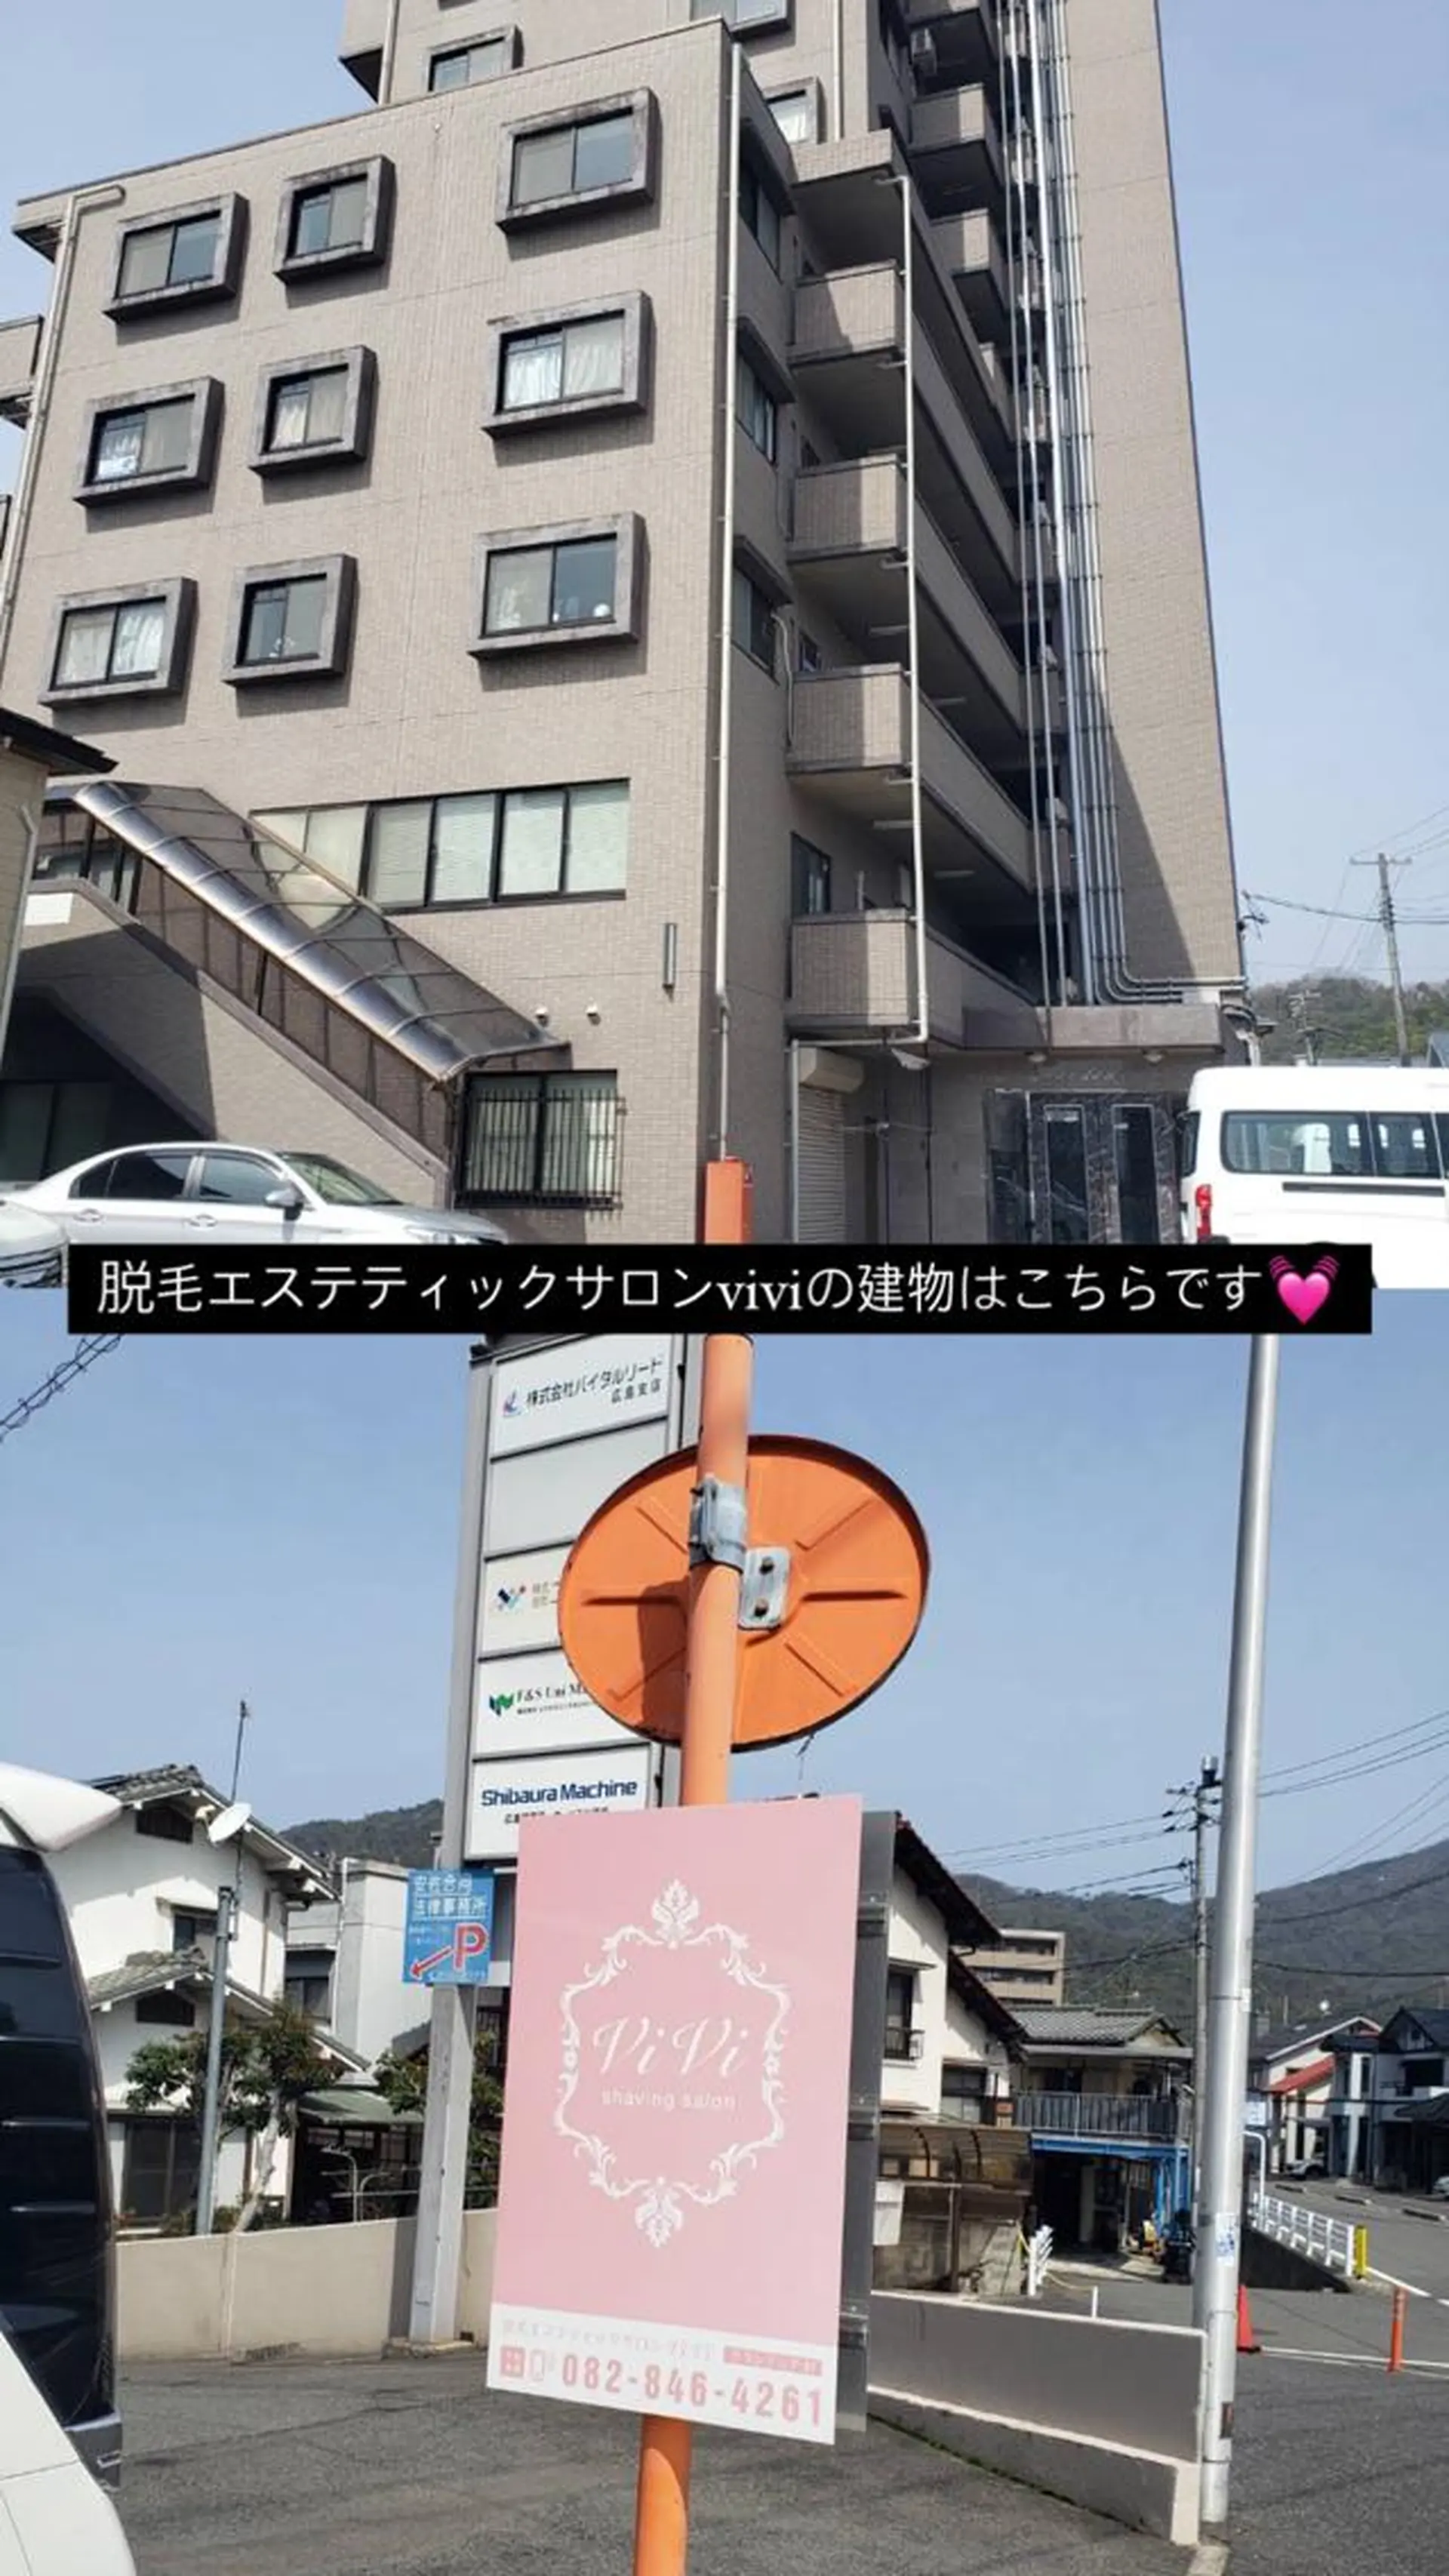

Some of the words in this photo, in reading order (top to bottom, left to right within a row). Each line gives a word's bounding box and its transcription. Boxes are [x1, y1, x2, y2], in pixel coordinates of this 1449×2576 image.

[481, 1785, 557, 1806] Shibaura
[560, 1779, 638, 1801] Machine
[453, 1922, 489, 1972] P
[601, 2088, 673, 2112] shaving
[682, 2091, 737, 2110] salon
[561, 2353, 822, 2426] 082-846-4261
